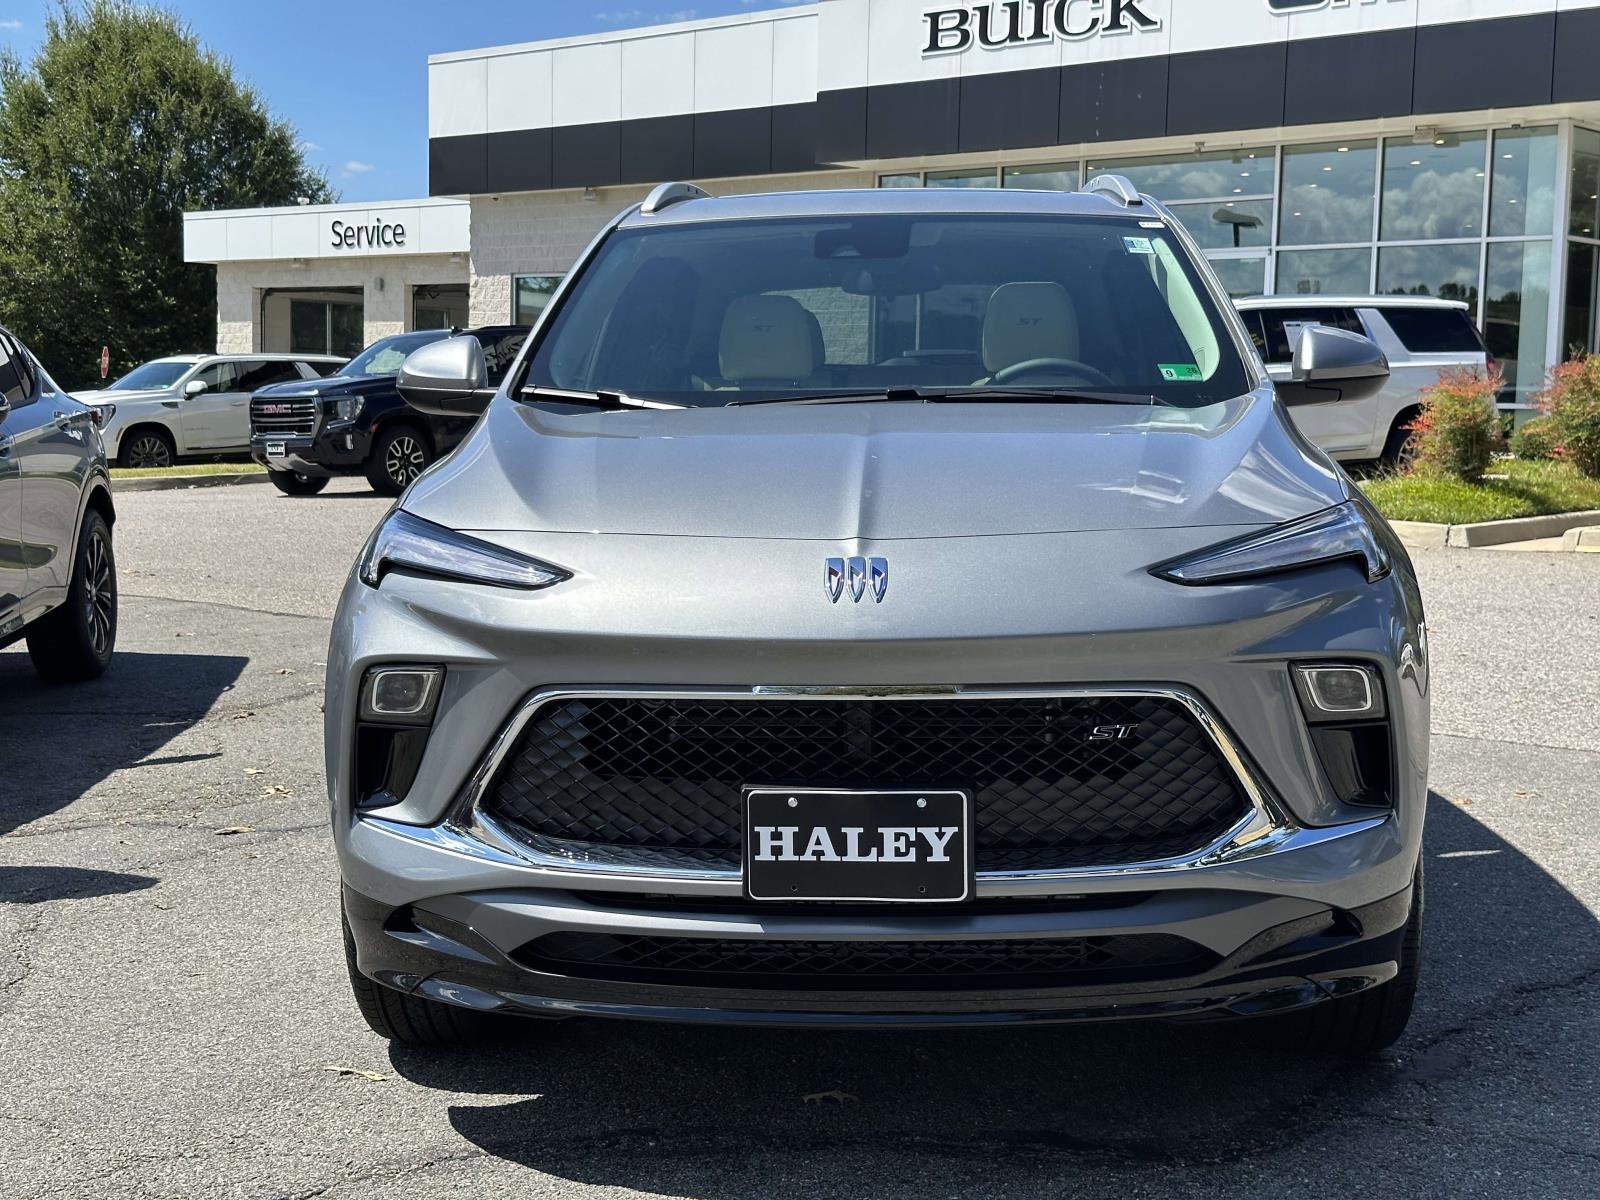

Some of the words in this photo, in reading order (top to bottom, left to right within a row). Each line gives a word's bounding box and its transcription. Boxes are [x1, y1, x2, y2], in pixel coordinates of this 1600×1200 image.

[921, 0, 1160, 54] BUICK
[331, 217, 405, 248] Service
[263, 404, 292, 414] GMC
[1089, 724, 1140, 740] ST
[754, 826, 958, 862] HALEY
